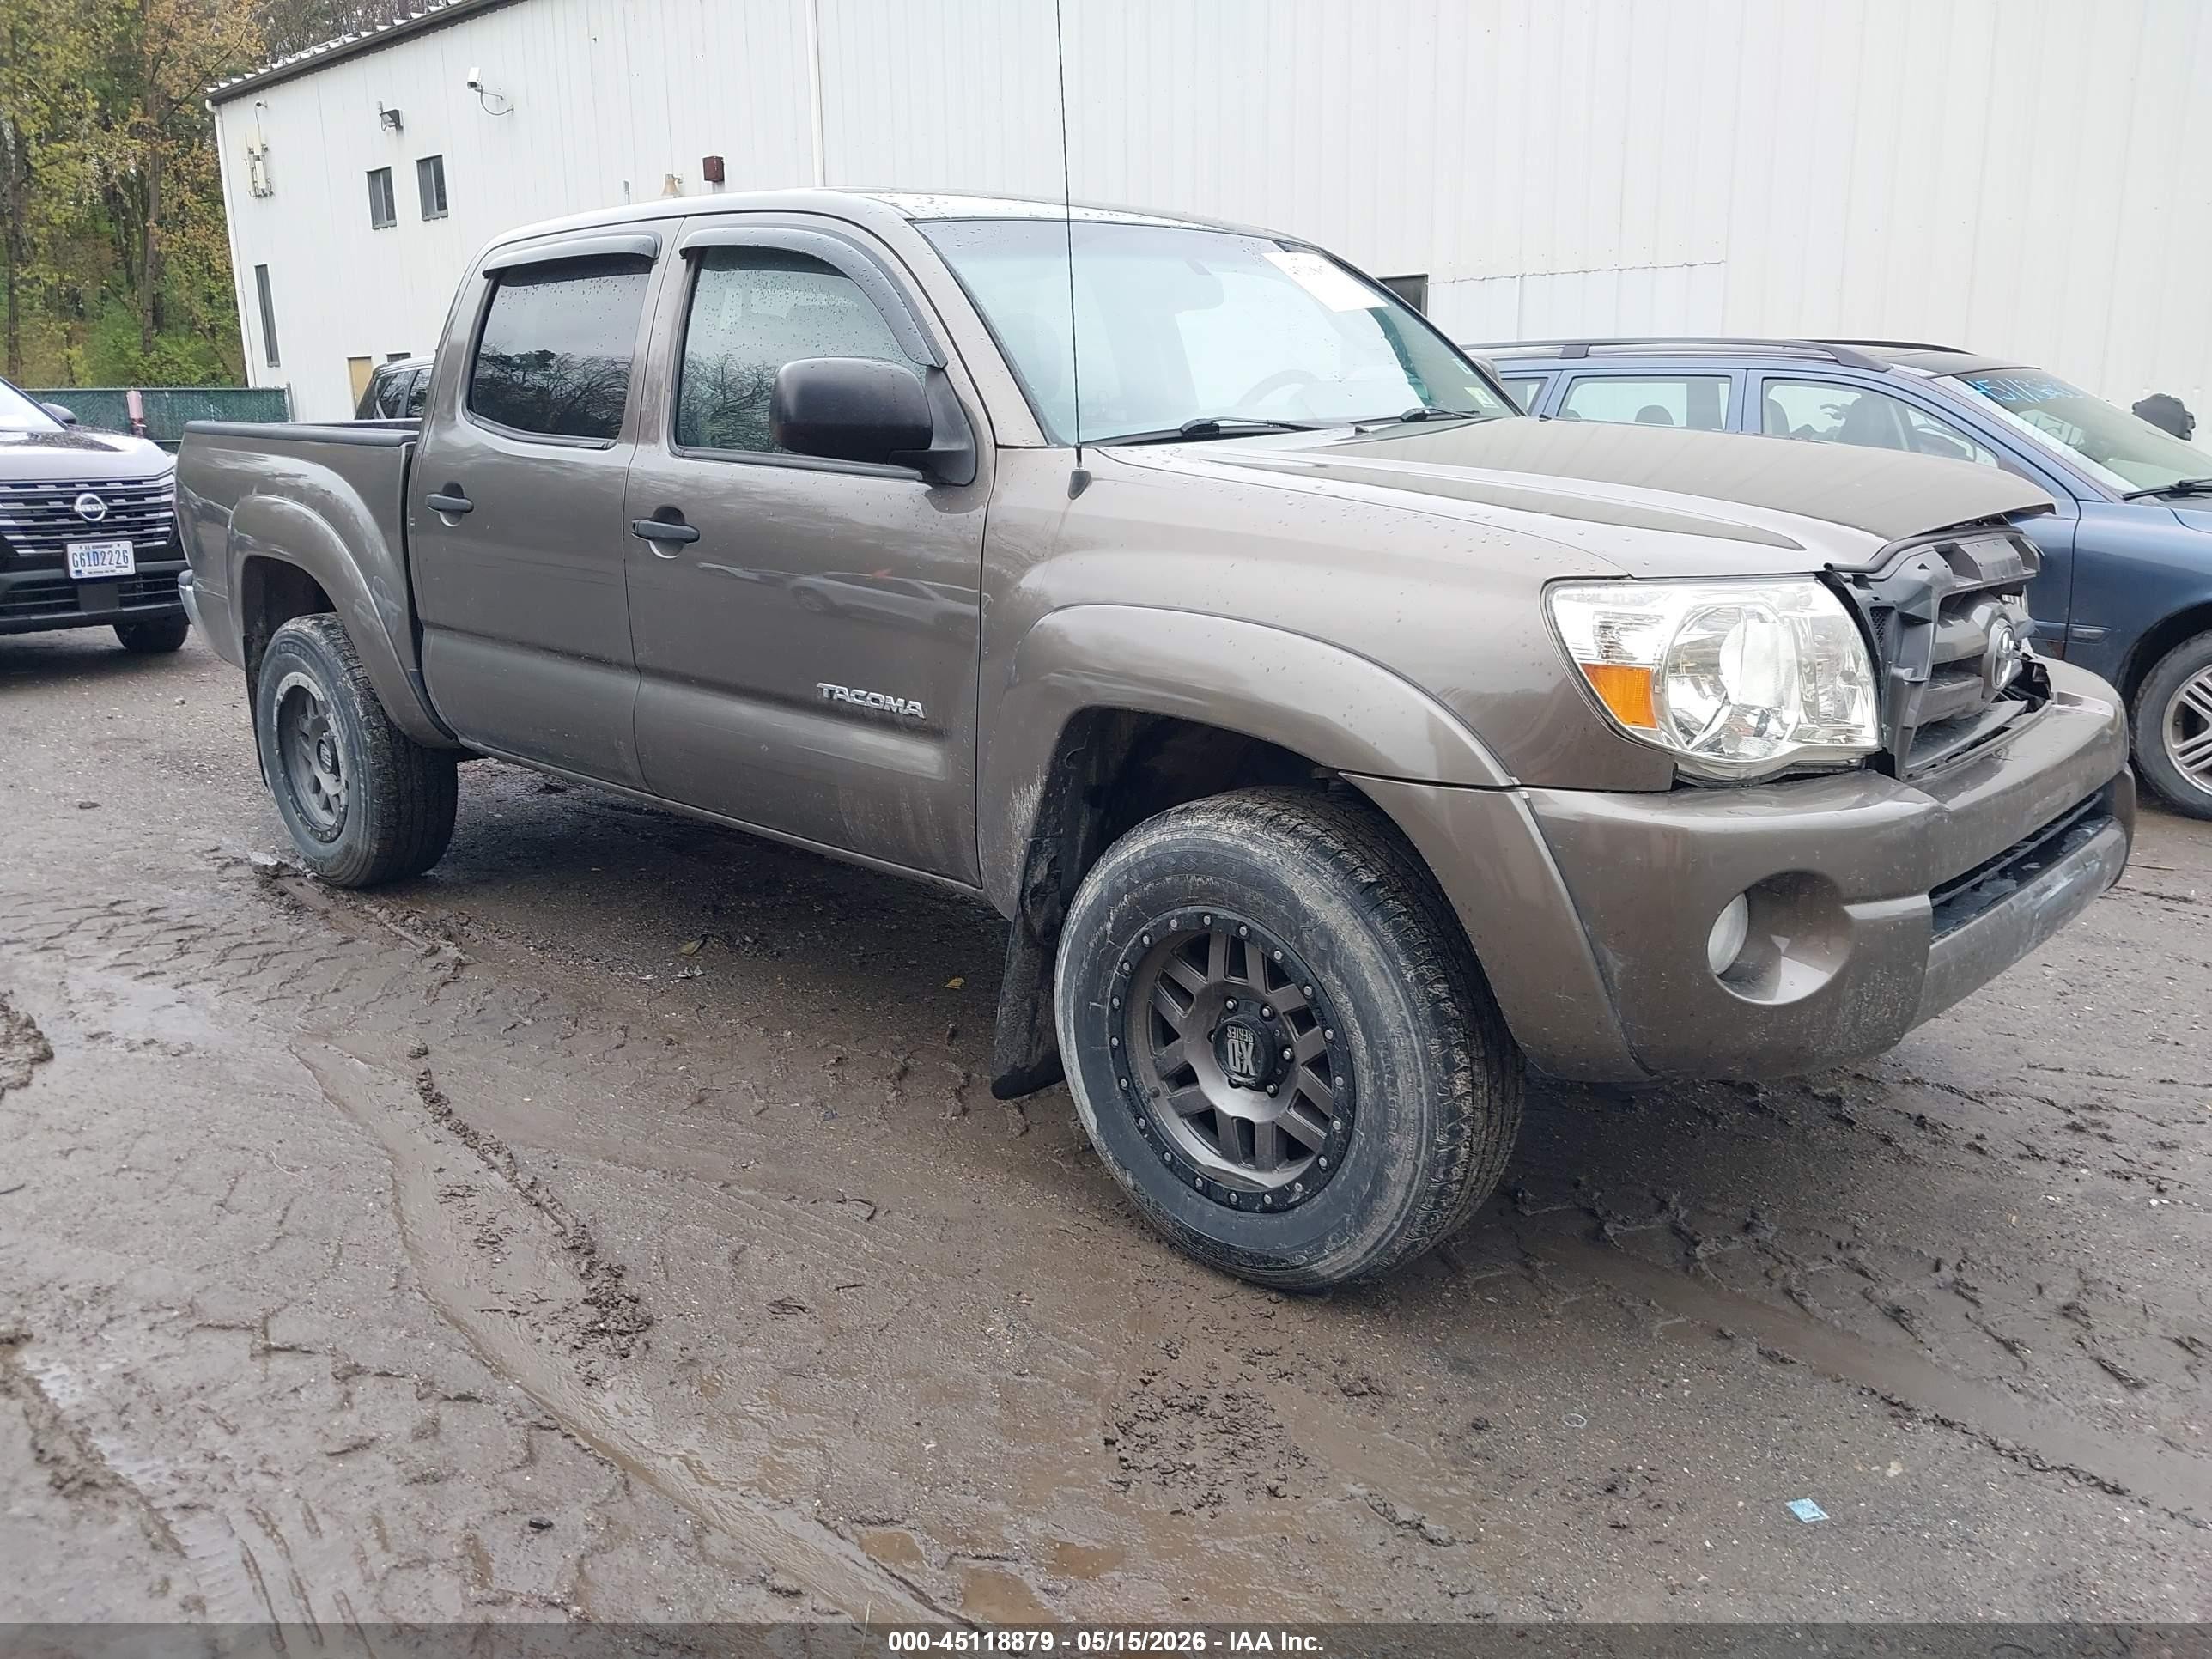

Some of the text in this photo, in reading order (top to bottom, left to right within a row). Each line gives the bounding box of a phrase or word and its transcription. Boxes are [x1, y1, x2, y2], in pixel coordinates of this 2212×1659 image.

[817, 682, 927, 720] TACOMA
[1226, 1024, 1255, 1042] SERIES
[1227, 1038, 1258, 1076] XD
